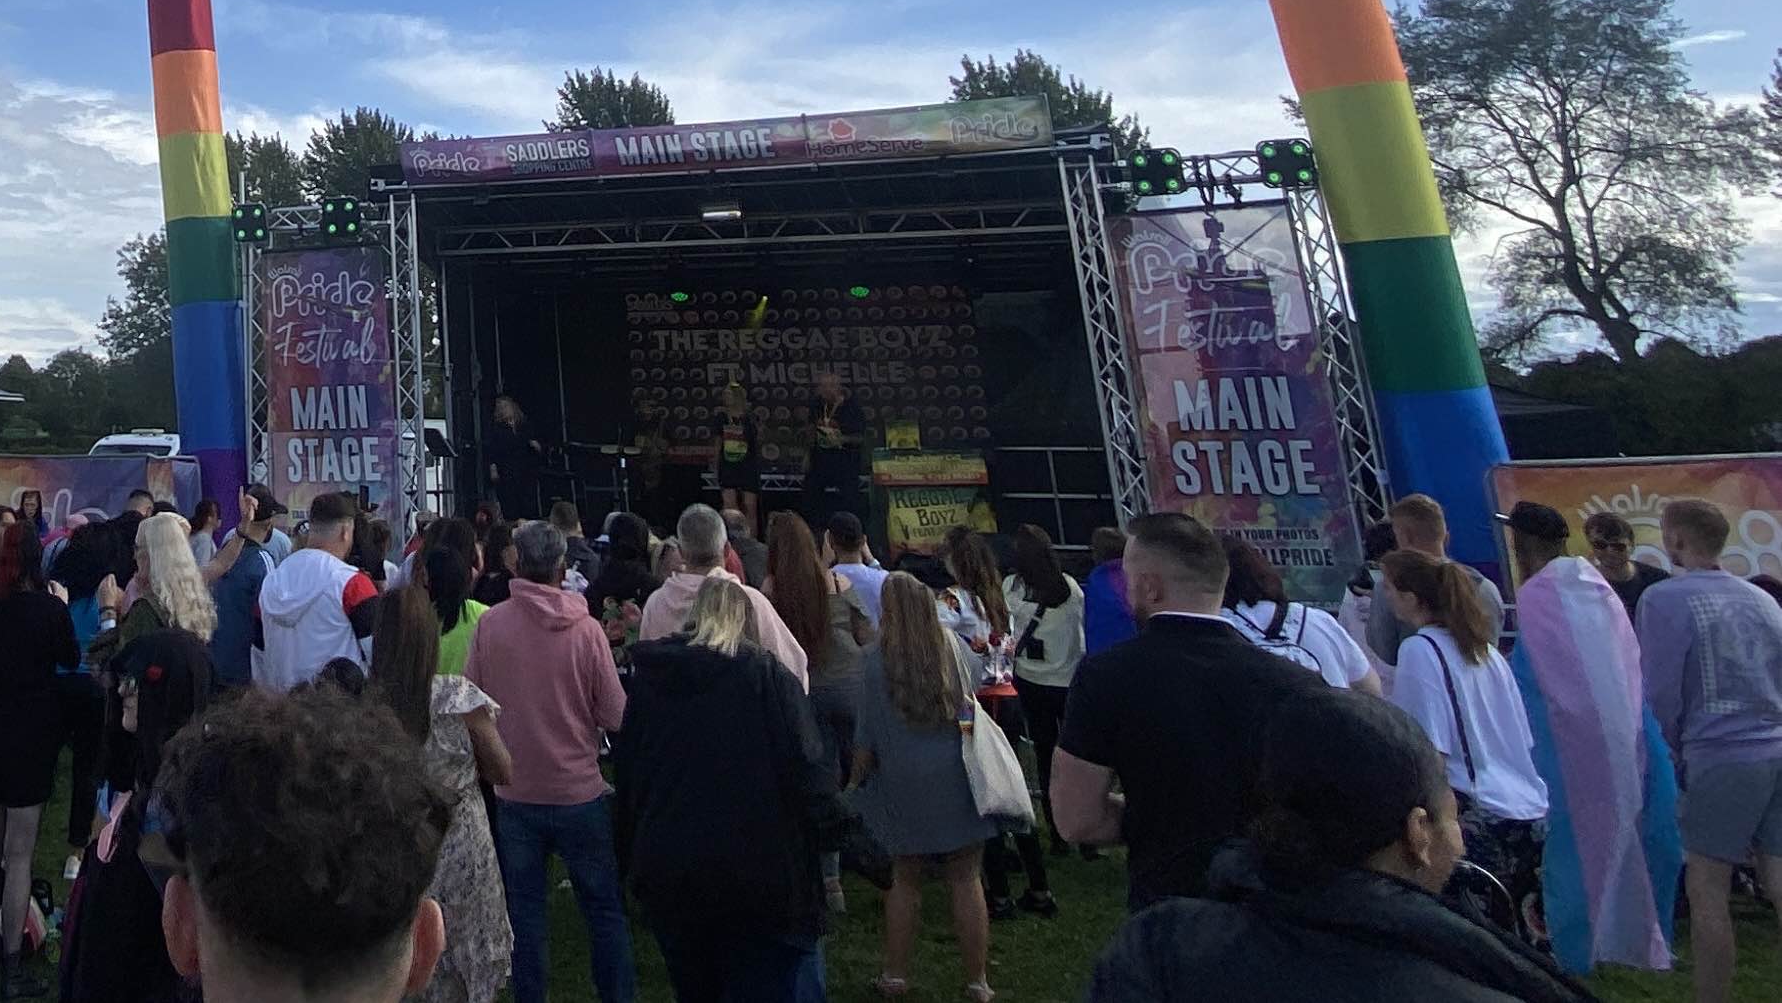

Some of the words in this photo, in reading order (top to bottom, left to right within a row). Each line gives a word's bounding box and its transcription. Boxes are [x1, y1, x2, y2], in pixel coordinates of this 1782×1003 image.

[412, 151, 482, 178] Pride
[505, 138, 591, 163] SADDLERS
[615, 134, 685, 166] MAIN
[690, 128, 777, 162] STAGE
[804, 135, 924, 159] HomeServe
[512, 160, 556, 175] SHOPPING
[557, 158, 594, 173] CENTRE
[272, 271, 375, 318] Pride
[274, 317, 378, 368] Festival
[654, 329, 709, 352] THE
[718, 326, 848, 351] REGGAE
[857, 324, 948, 350] BOYZ
[1142, 292, 1300, 358] Festival
[707, 363, 741, 384] FT
[749, 361, 907, 385] MICHELLE
[290, 384, 369, 430] MAIN
[1174, 376, 1297, 431] MAIN
[288, 436, 382, 483] STAGE
[1172, 439, 1321, 496] STAGE
[1244, 528, 1274, 541] YOUR
[1275, 527, 1320, 541] PHOTOS
